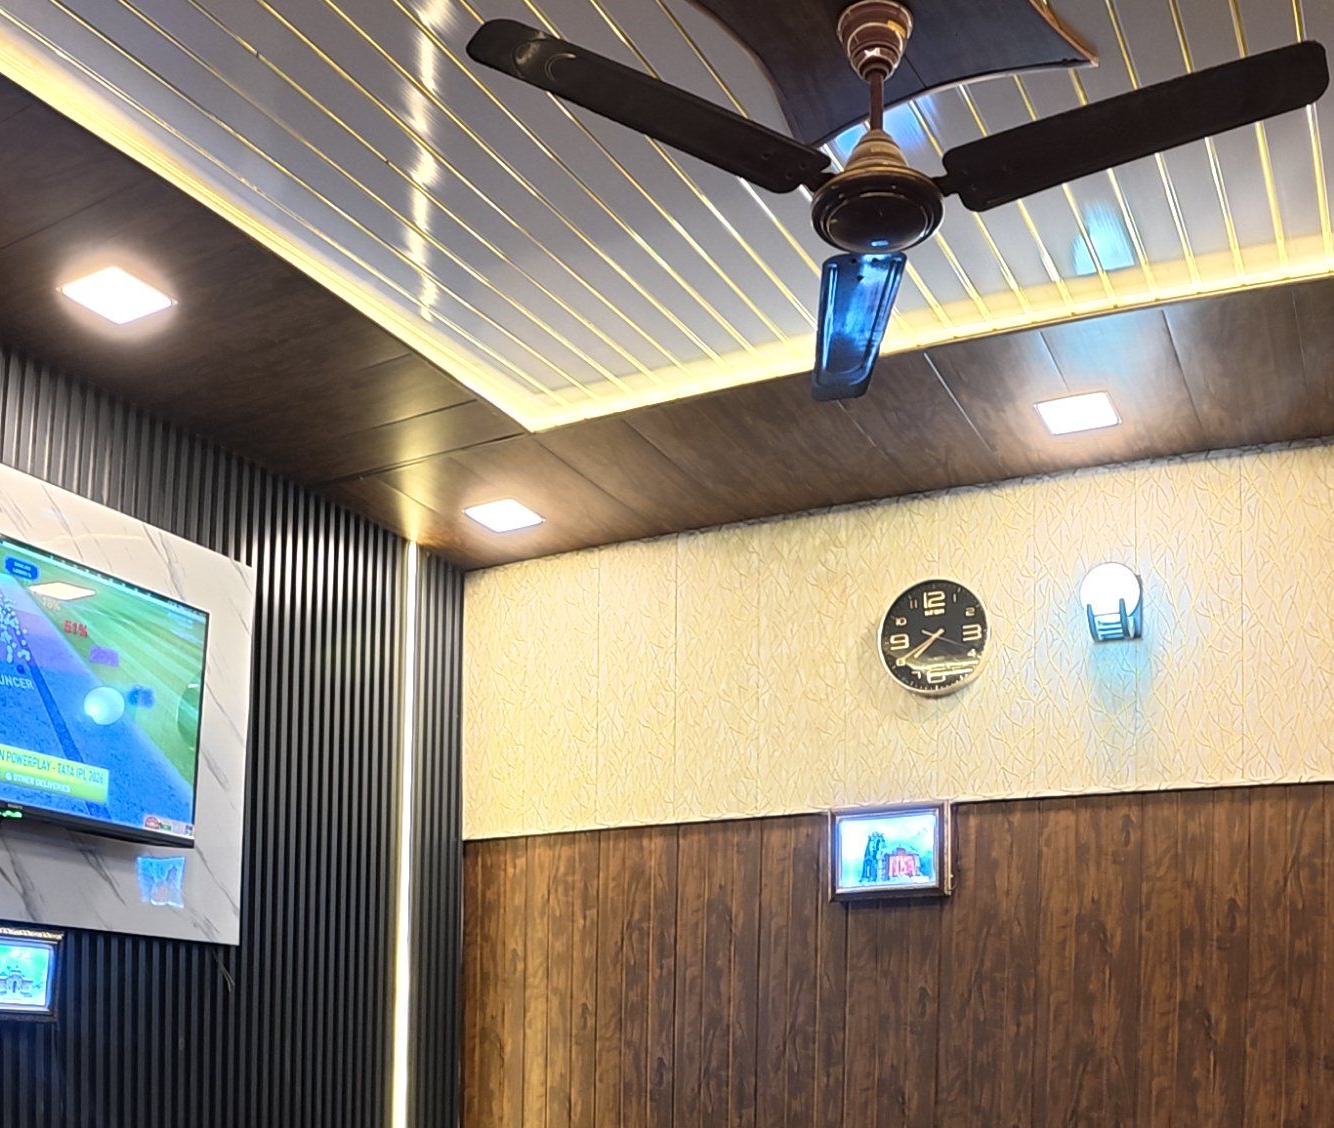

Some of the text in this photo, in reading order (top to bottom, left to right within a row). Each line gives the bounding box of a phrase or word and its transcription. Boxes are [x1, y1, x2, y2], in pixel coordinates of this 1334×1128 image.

[923, 591, 946, 609] 12
[965, 607, 975, 616] 2
[889, 633, 910, 651] 9
[962, 624, 982, 642] 3
[6, 752, 51, 771] POWERPLAY
[58, 762, 75, 777] TATA
[76, 767, 88, 781] IPL
